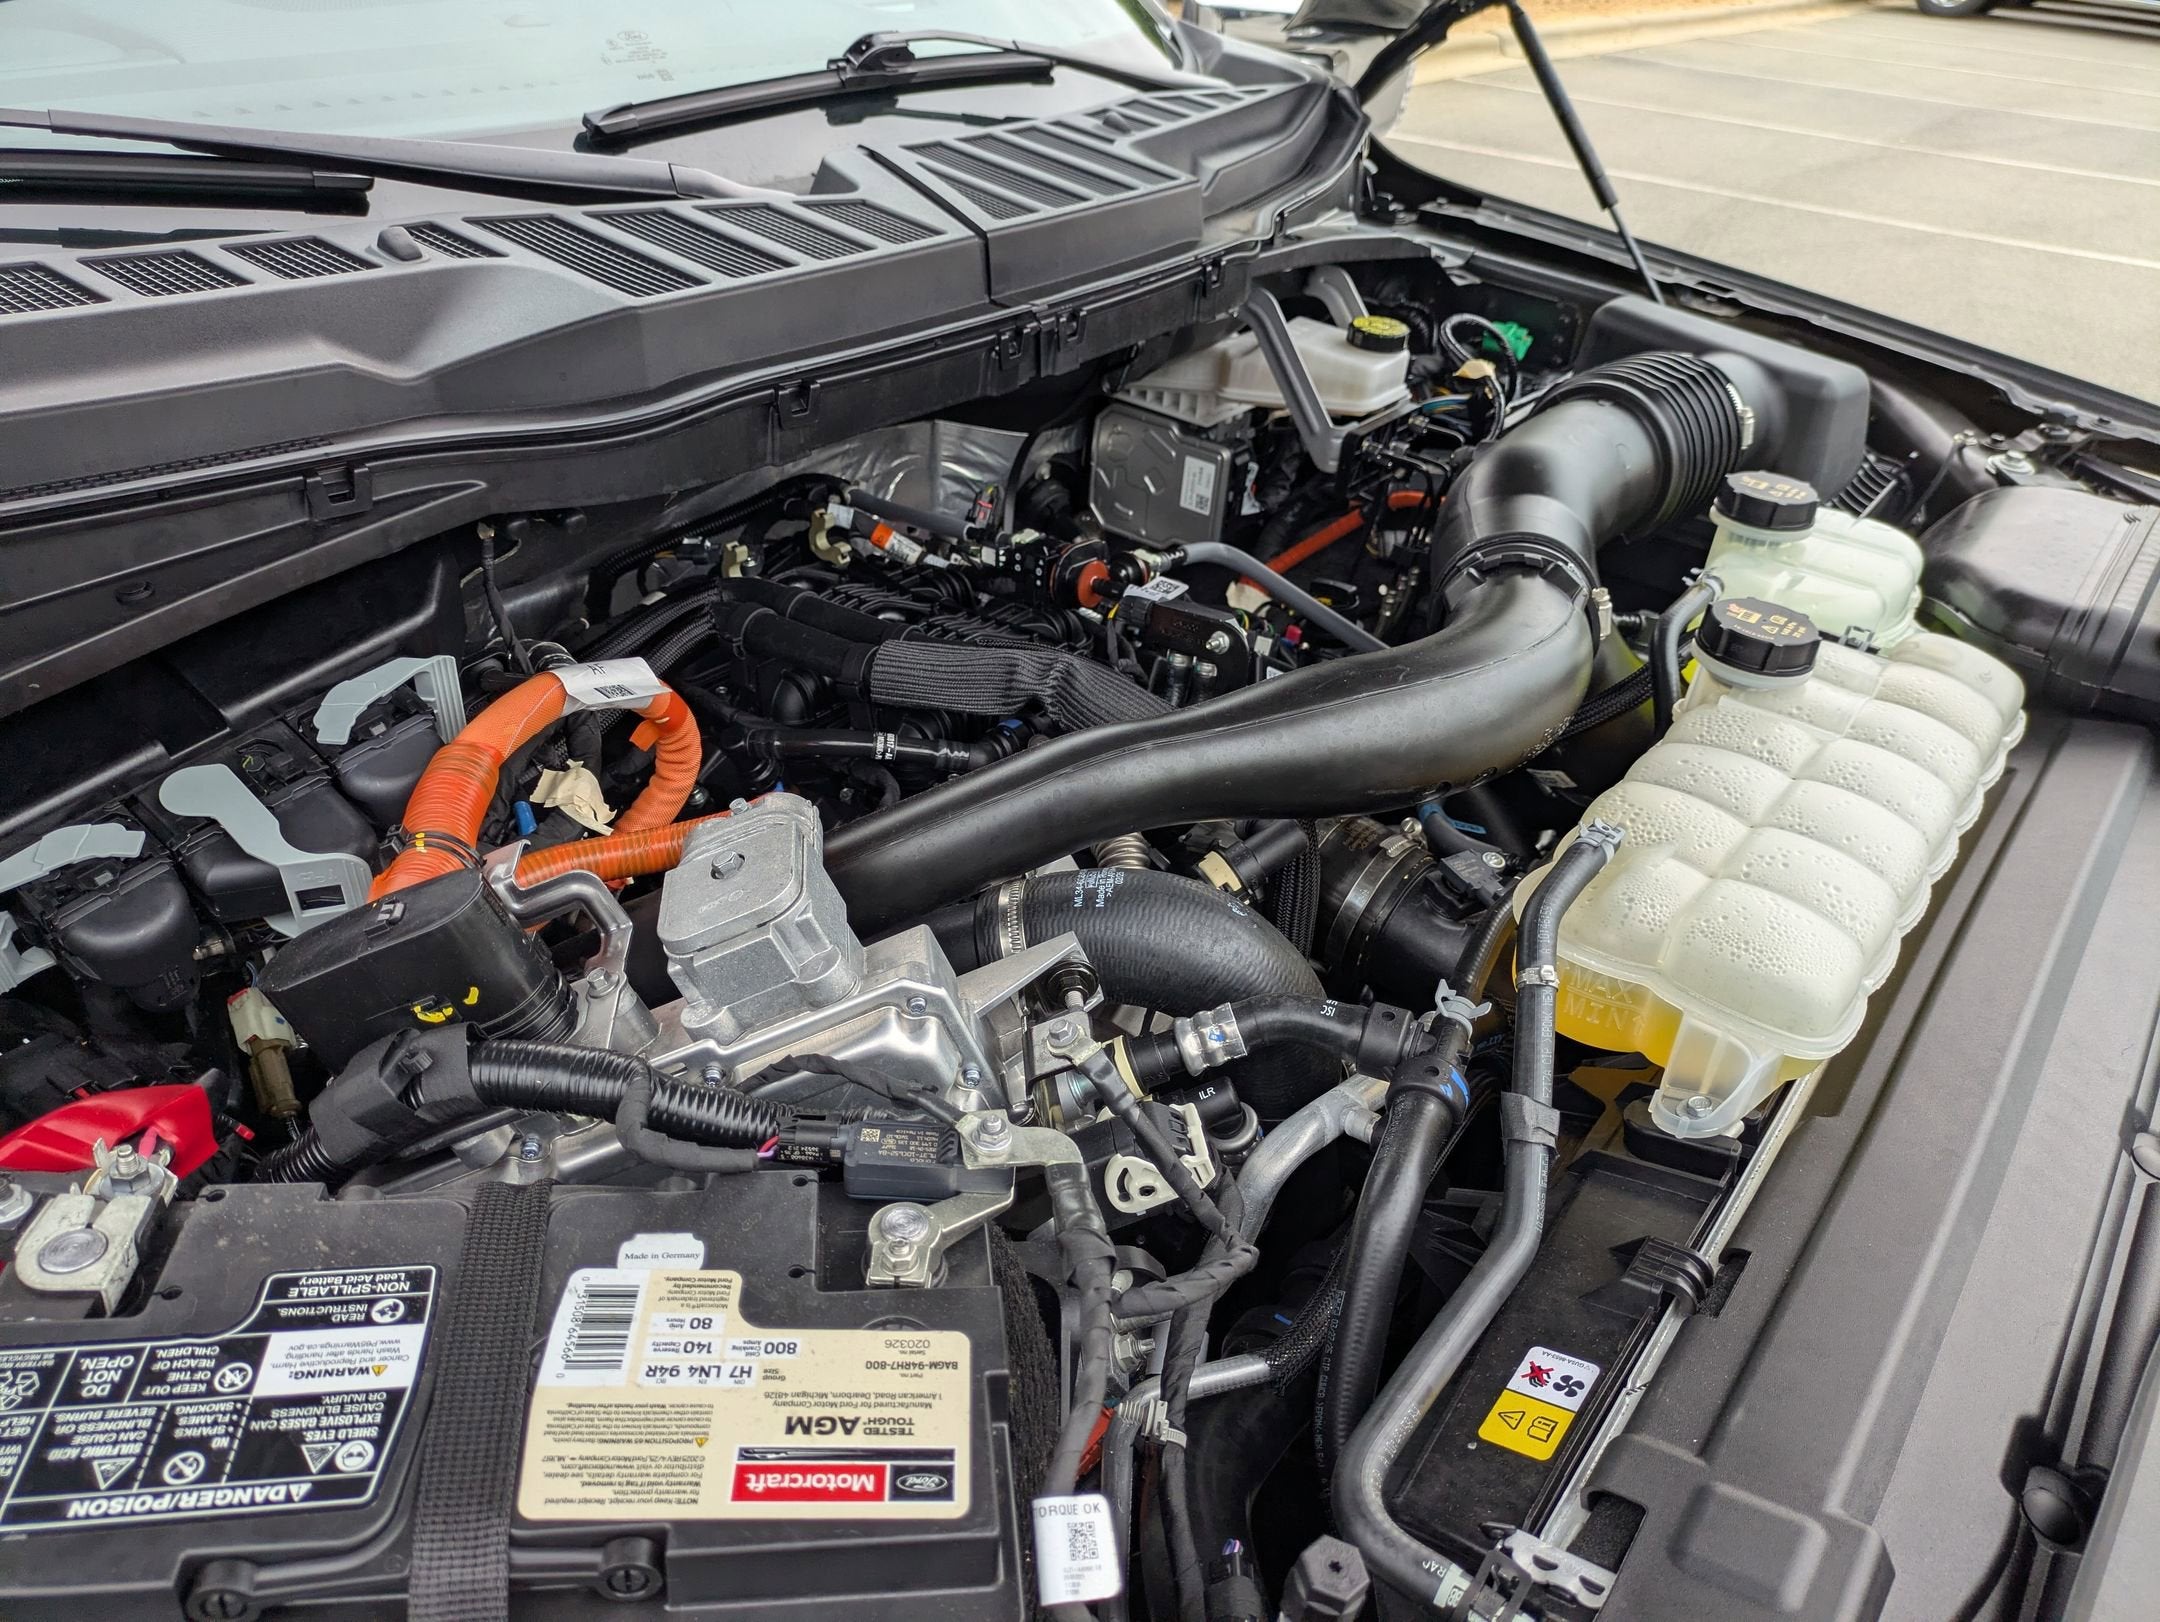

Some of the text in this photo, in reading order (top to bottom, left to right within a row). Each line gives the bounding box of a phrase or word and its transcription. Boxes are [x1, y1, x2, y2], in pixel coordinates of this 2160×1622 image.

[1096, 886, 1105, 907] Made
[1569, 966, 1636, 1003] MAX
[1320, 1005, 1335, 1016] ISC
[1563, 993, 1629, 1031] MIN
[1199, 1087, 1216, 1099] ILR
[299, 1273, 405, 1285] Lead Acid Battery
[287, 1281, 410, 1297] NON-SPILLABLE
[278, 1304, 368, 1316] INSTRUCTIONS.
[332, 1313, 366, 1322] READ
[690, 1318, 713, 1329] 80
[288, 1339, 401, 1351] www.P65Warnings.ca.gov
[560, 1327, 578, 1360] 64566
[684, 1341, 713, 1354] 140
[764, 1342, 797, 1354] 800
[884, 1339, 930, 1348] 020326
[155, 1345, 220, 1358] CHILDREN.
[284, 1351, 323, 1361] handling.
[325, 1350, 346, 1358] after
[347, 1348, 374, 1356] hands
[80, 1355, 135, 1369] OPEN.
[151, 1358, 215, 1371] REACH OF
[300, 1357, 357, 1368] Reproductive
[378, 1354, 410, 1363] Cancer
[270, 1362, 298, 1370] Harm.
[645, 1365, 752, 1378] H7 LN4 94R
[865, 1361, 958, 1370] BAGM-94RH7-800
[80, 1369, 122, 1384] NOT
[166, 1370, 211, 1382] OF THE
[288, 1366, 370, 1379] WARNING:
[81, 1384, 111, 1397] DO
[142, 1384, 207, 1396] KEEP OUT
[764, 1391, 789, 1399] 48126
[791, 1390, 828, 1400] Michigan
[830, 1391, 871, 1400] Dearborn,
[873, 1391, 896, 1400] Road,
[898, 1392, 938, 1400] American
[322, 1392, 386, 1404] OR INJURY.
[773, 1399, 812, 1408] Company
[174, 1401, 234, 1415] SMOKING
[271, 1402, 384, 1418] CAUSE BLINDNESS
[860, 1401, 872, 1409] for
[873, 1401, 932, 1409] Manufactured
[54, 1406, 157, 1422] SEVERE BURNS.
[178, 1413, 230, 1425] FLAMES
[54, 1418, 152, 1435] BLINDNESS OR
[250, 1413, 382, 1430] EXPLOSIVE GASES CAN
[785, 1416, 861, 1435] AGM
[5, 1425, 31, 1436] GET
[173, 1425, 226, 1438] SPARKS
[302, 1426, 379, 1441] SHIELD EYES.
[863, 1427, 914, 1436] TESTED
[71, 1430, 147, 1445] CAN CAUSE
[210, 1436, 230, 1448] NO
[46, 1442, 143, 1461] SULFURIC ACID
[625, 1479, 638, 1487] tag
[746, 1473, 875, 1492] Motorcraft
[613, 1488, 653, 1496] protection.
[66, 1484, 288, 1518] DANGER/POISON
[1083, 1503, 1101, 1514] OK
